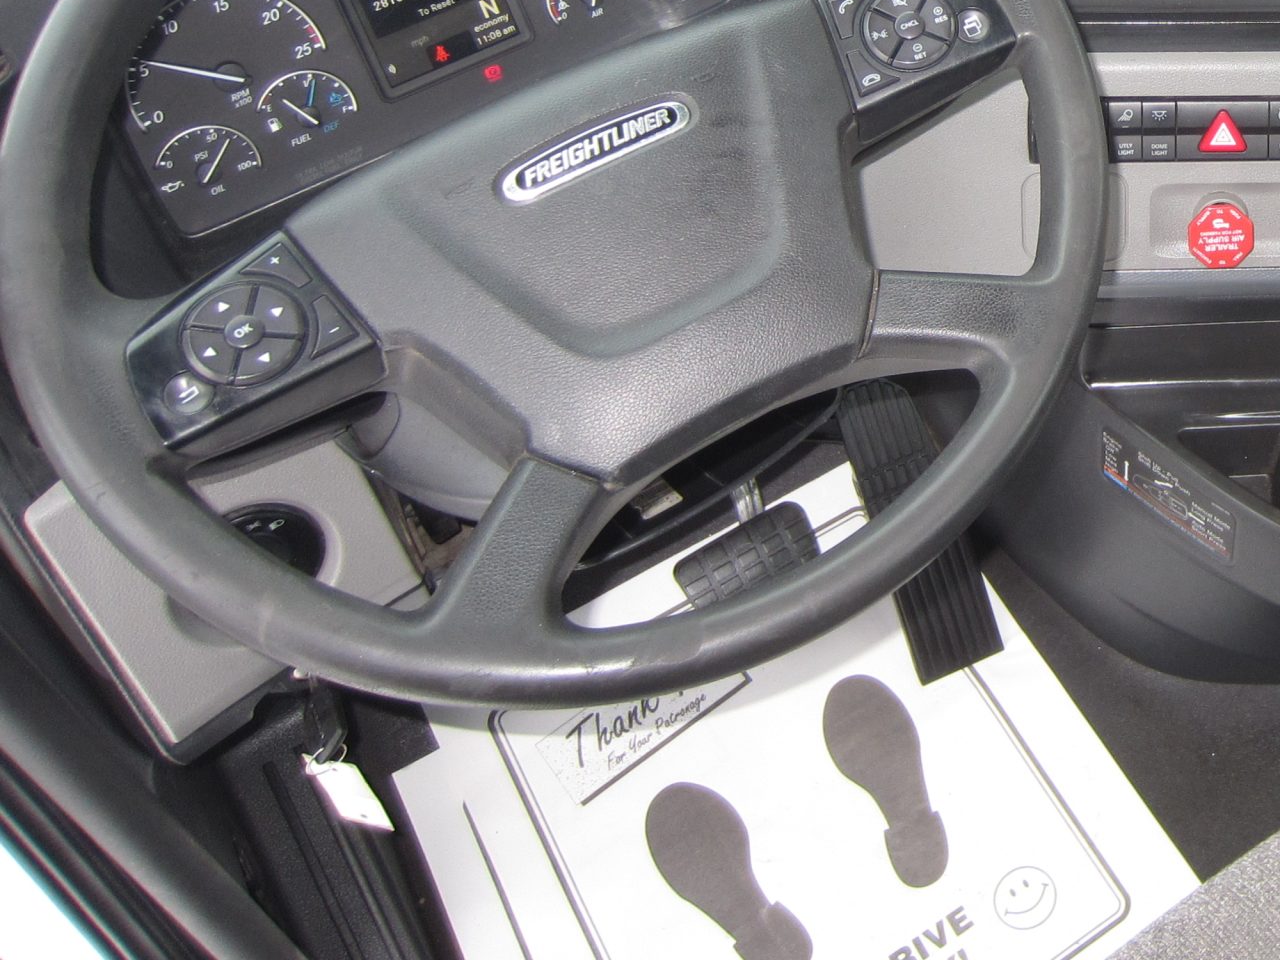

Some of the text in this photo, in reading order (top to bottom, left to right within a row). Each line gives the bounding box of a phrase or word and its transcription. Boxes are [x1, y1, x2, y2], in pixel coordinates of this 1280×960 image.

[262, 9, 280, 25] 20
[417, 6, 430, 18] To
[591, 8, 604, 18] AIR
[473, 12, 510, 33] economy
[934, 14, 949, 25] RES
[162, 21, 178, 35] 10
[476, 24, 516, 46] 11:08 am
[294, 42, 312, 59] 25
[914, 50, 927, 61] SET
[139, 64, 149, 78] 5
[231, 88, 250, 103] RPM
[153, 110, 164, 123] 0
[205, 132, 218, 143] 50
[291, 133, 312, 147] FUEL
[523, 108, 672, 188] FREIGHTLINER
[194, 150, 209, 162] PSI
[236, 160, 252, 172] 100
[210, 184, 227, 196] OIL
[1198, 234, 1245, 244] AIR SUPPLY
[1204, 243, 1239, 252] TRAILER
[233, 321, 254, 339] OK
[607, 693, 707, 771] For Your Patronage
[888, 905, 975, 960] RIVE
